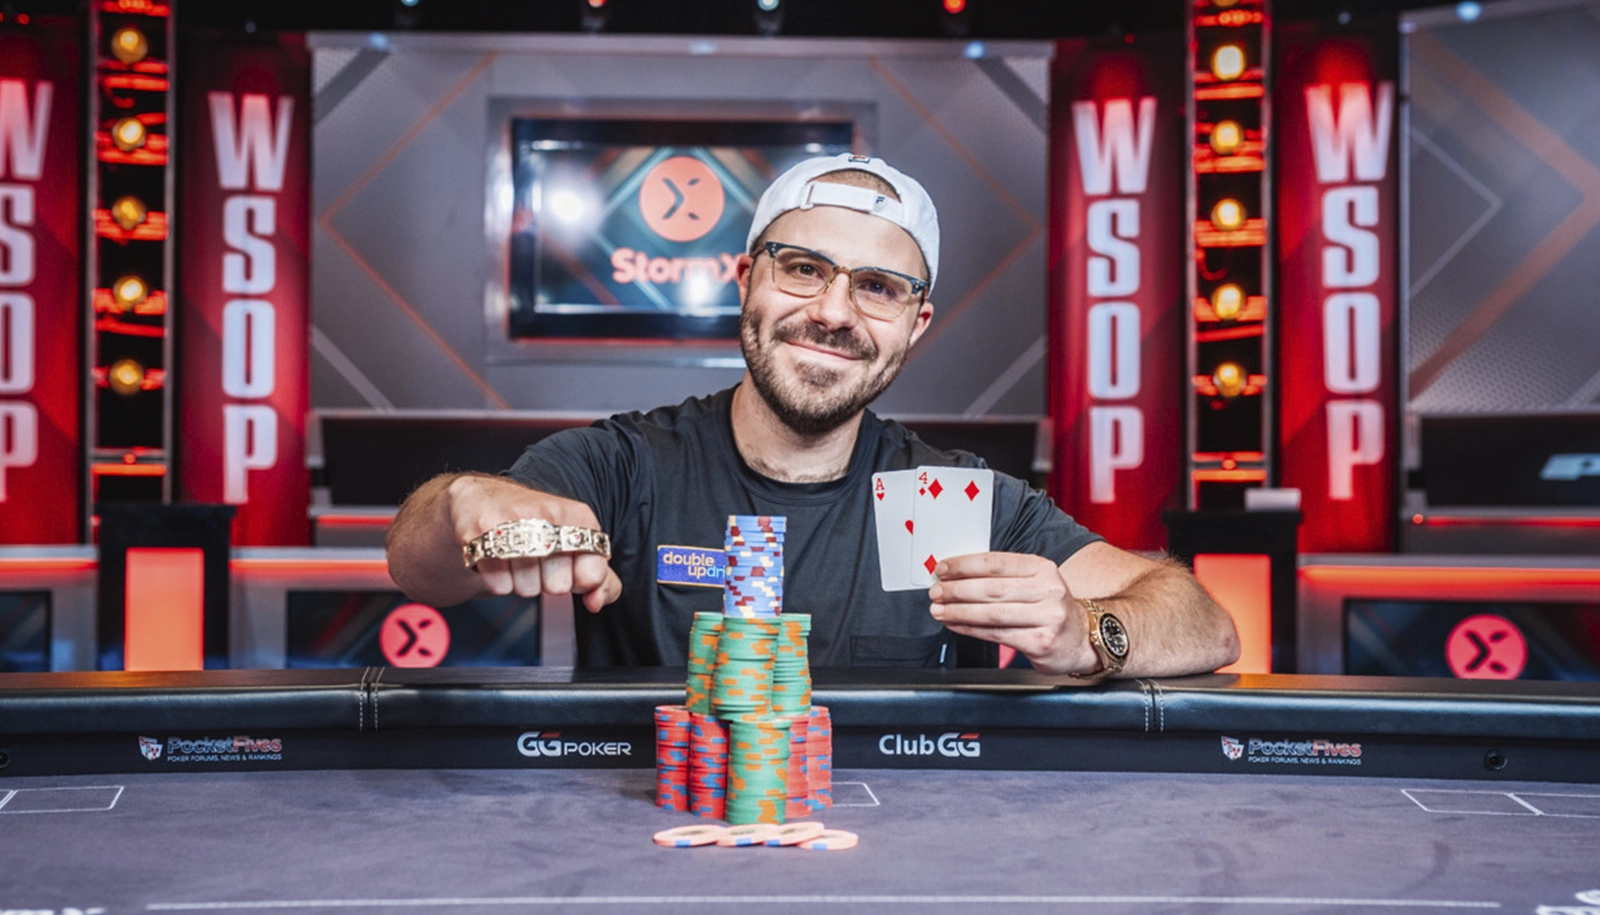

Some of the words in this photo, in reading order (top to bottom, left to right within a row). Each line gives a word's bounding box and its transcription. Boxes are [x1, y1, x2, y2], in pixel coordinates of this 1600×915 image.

[209, 93, 295, 504] WSOP
[1306, 84, 1394, 500] WSOP
[1072, 98, 1157, 504] WSOP
[875, 478, 885, 491] A
[919, 471, 928, 484] 4
[663, 551, 715, 567] double
[688, 565, 725, 580] updri
[167, 736, 282, 753] PocketFives
[879, 732, 981, 757] ClubGG
[1247, 738, 1362, 757] PocketFives
[1321, 757, 1327, 765] &
